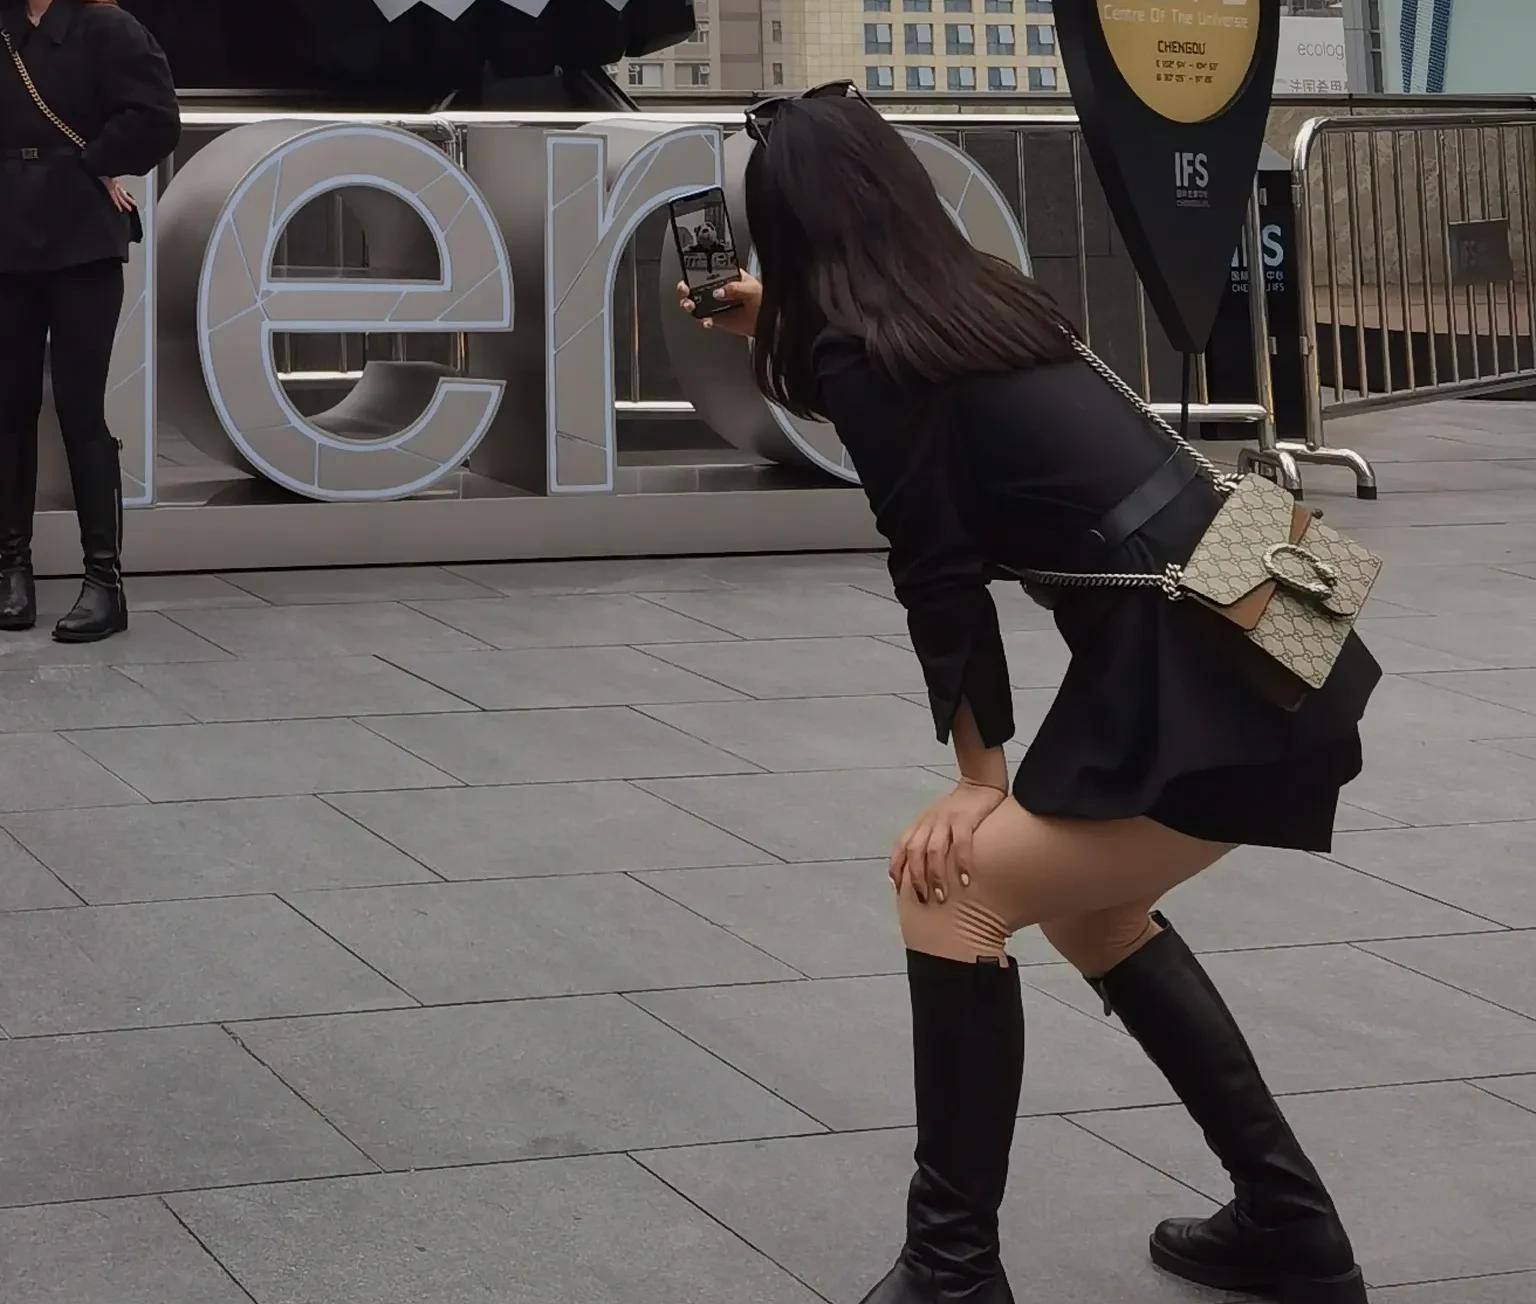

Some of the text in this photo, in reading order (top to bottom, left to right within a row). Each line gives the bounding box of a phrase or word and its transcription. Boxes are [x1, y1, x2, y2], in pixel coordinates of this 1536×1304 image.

[1171, 8, 1193, 25] The
[1157, 40, 1206, 55] CHENGDU
[1175, 152, 1209, 187] IFS
